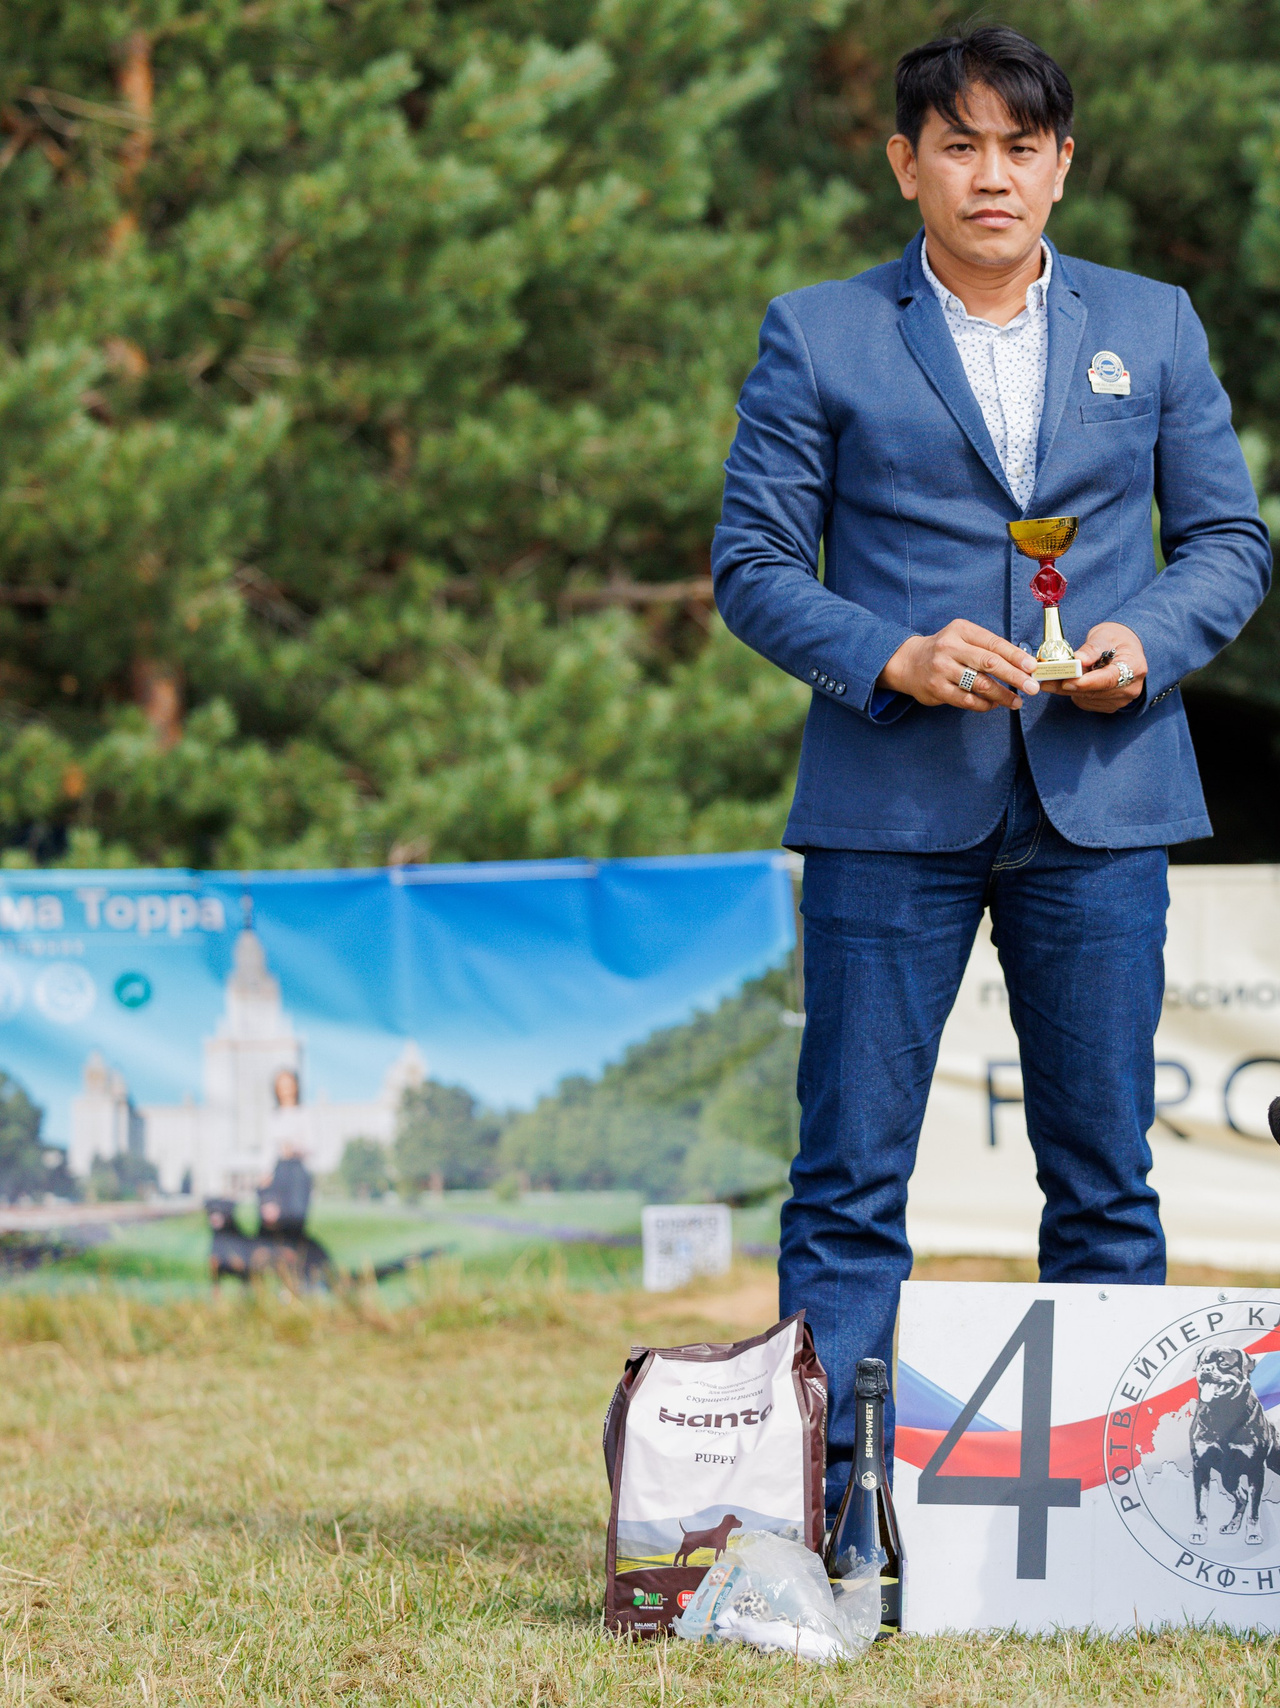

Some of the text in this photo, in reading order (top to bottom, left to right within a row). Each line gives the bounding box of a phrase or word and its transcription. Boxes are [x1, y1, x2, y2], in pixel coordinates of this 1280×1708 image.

[695, 1453, 737, 1464] PUPPY
[865, 1402, 874, 1458] SEMI-SWEET
[917, 1299, 1081, 1579] 4
[1109, 1311, 1224, 1512] РОТВЕЙЛЕР
